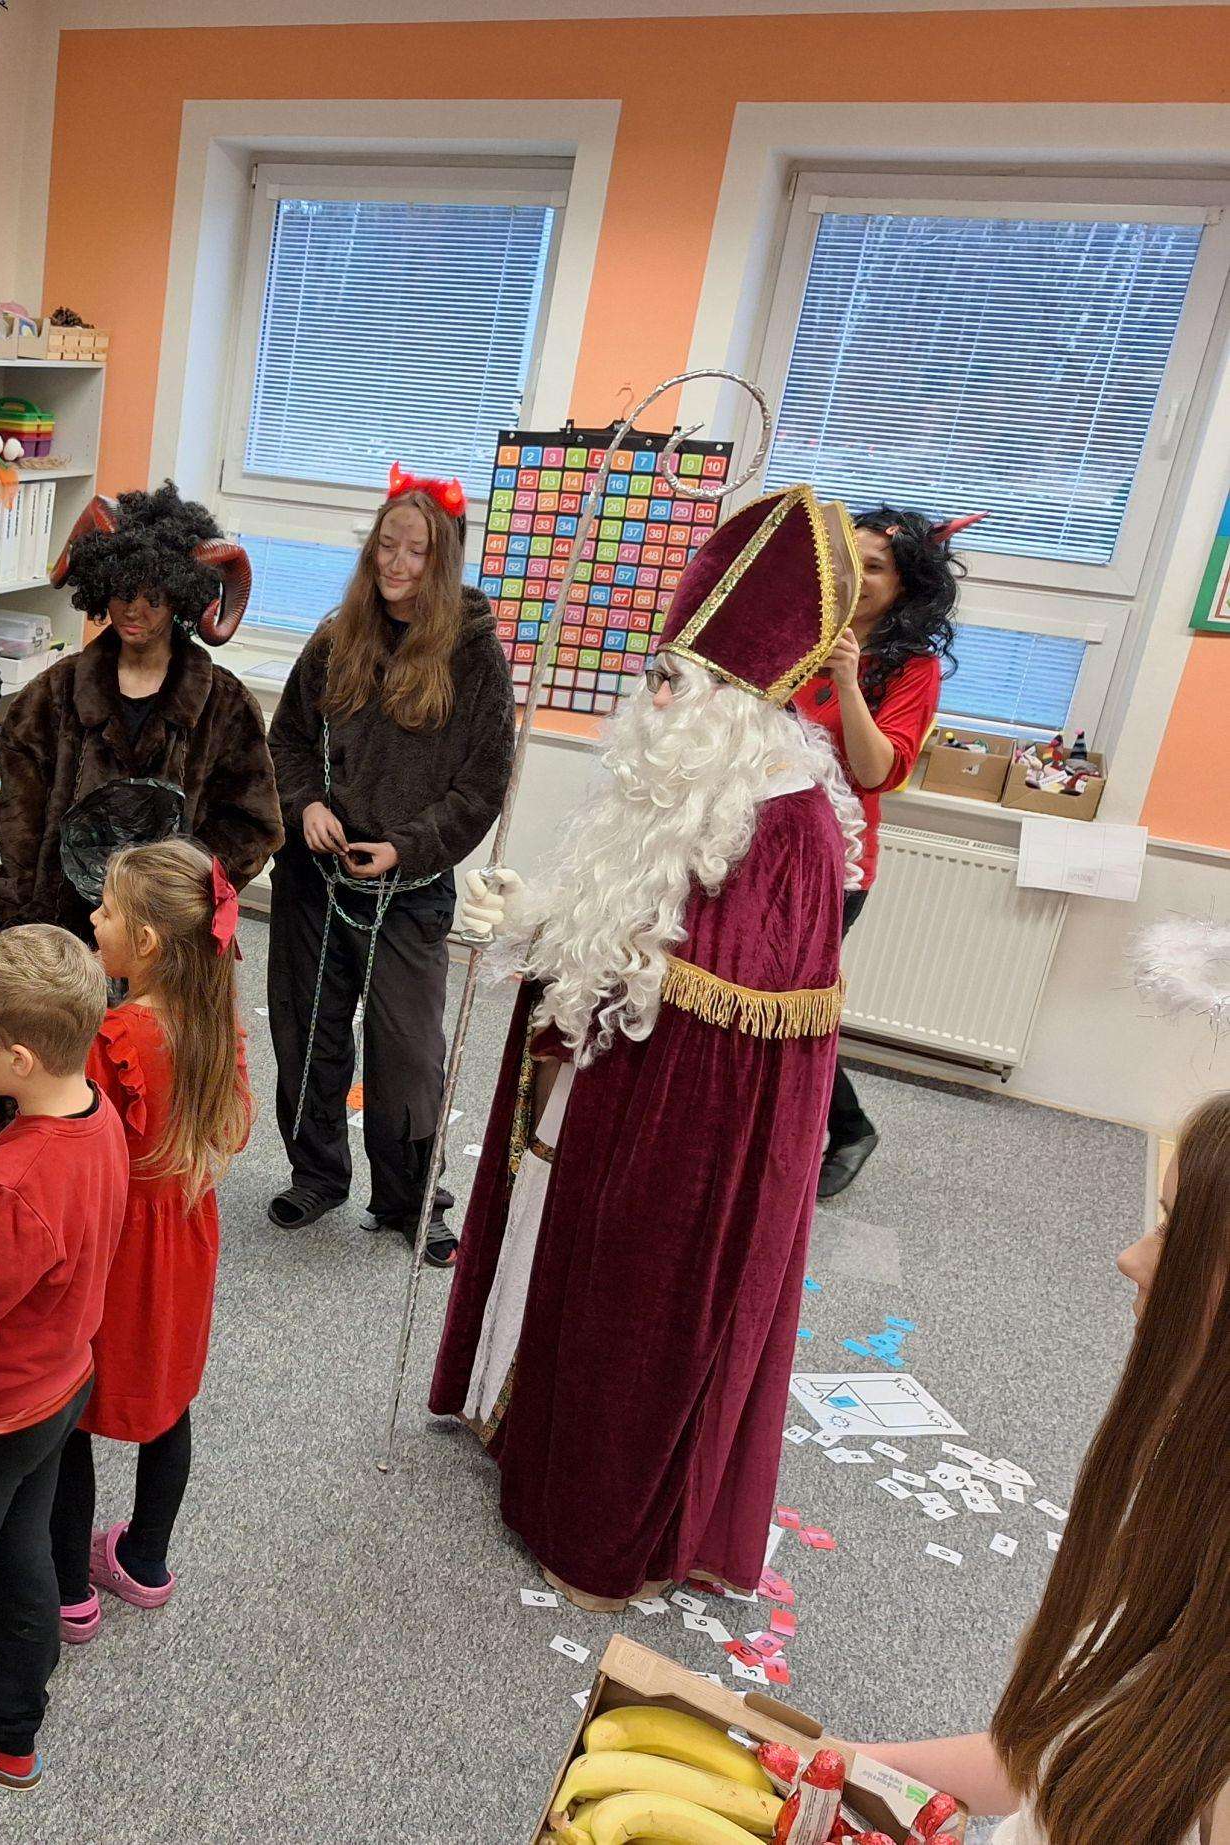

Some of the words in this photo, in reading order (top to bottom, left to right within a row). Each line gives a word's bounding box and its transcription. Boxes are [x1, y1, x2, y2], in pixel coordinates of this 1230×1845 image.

[505, 452, 512, 461] 1
[526, 452, 535, 462] 2
[548, 453, 557, 463] 3
[571, 454, 579, 464] 4
[594, 455, 602, 464] 5
[617, 456, 625, 466] 6
[639, 457, 648, 467] 7
[687, 460, 695, 470] 9
[707, 461, 721, 472] 10
[498, 474, 510, 483] 11
[521, 475, 534, 485] 12
[566, 477, 579, 487] 14
[611, 480, 624, 490] 16
[633, 481, 646, 490] 17
[656, 483, 669, 492] 18
[496, 496, 509, 505] 21
[518, 496, 532, 506] 22
[541, 497, 554, 507] 23
[562, 499, 577, 509] 24
[607, 503, 621, 512] 26
[629, 504, 644, 514] 27
[652, 505, 666, 515] 28
[674, 506, 689, 517] 29
[697, 508, 713, 518] 30
[513, 519, 527, 529] 32
[536, 520, 551, 530] 33
[558, 522, 572, 531] 34
[626, 527, 641, 537] 37
[649, 528, 663, 538] 38
[671, 530, 686, 540] 39
[694, 531, 710, 541] 40
[490, 540, 502, 549] 41
[510, 541, 525, 550] 42
[555, 543, 570, 553] 44
[621, 549, 636, 558] 47
[645, 551, 659, 560] 48
[667, 553, 682, 563] 49
[486, 561, 499, 570] 51
[508, 562, 521, 571] 52
[552, 565, 566, 575] 54
[596, 569, 610, 579] 56
[617, 571, 632, 581] 57
[484, 582, 496, 592] 61
[527, 585, 540, 595] 63
[571, 588, 584, 598] 65
[592, 591, 606, 601] 66
[614, 592, 629, 603] 67
[637, 594, 651, 605] 68
[502, 605, 515, 616] 72
[568, 610, 581, 620] 75
[611, 615, 624, 625] 77
[498, 626, 512, 636] 82
[520, 627, 534, 637] 83
[563, 631, 577, 640] 85
[607, 636, 622, 646] 87
[517, 649, 531, 659] 93
[560, 652, 574, 662] 95
[604, 656, 618, 667] 97
[626, 659, 640, 670] 98
[938, 1472, 948, 1481] 0
[955, 1475, 965, 1484] 0
[887, 1483, 899, 1493] 0
[935, 1507, 947, 1516] 0
[937, 1549, 952, 1559] 0
[562, 1643, 577, 1653] 0
[733, 1645, 753, 1660] 10
